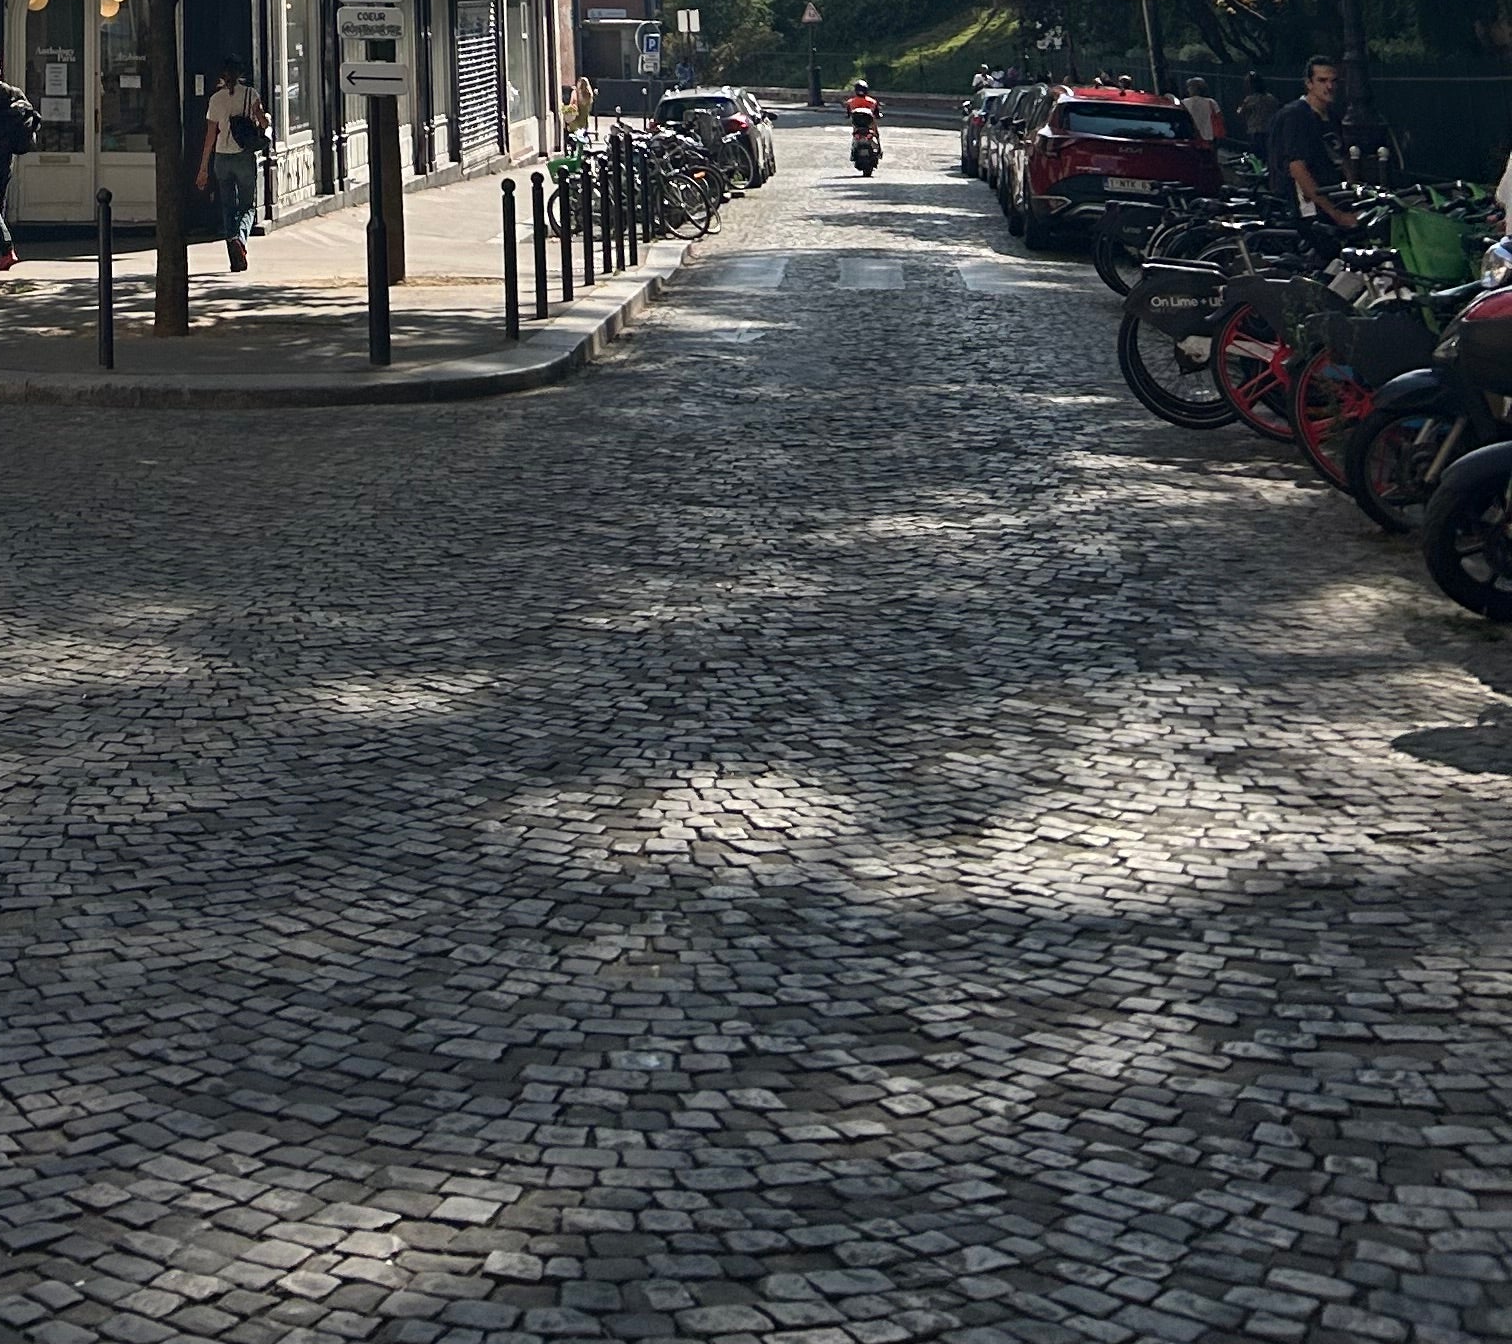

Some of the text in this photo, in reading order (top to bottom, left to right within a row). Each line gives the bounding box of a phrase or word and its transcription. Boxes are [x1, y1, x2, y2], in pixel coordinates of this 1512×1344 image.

[357, 12, 386, 22] COEUR
[648, 40, 656, 49] P
[1150, 296, 1169, 307] On
[1170, 296, 1199, 307] Lime
